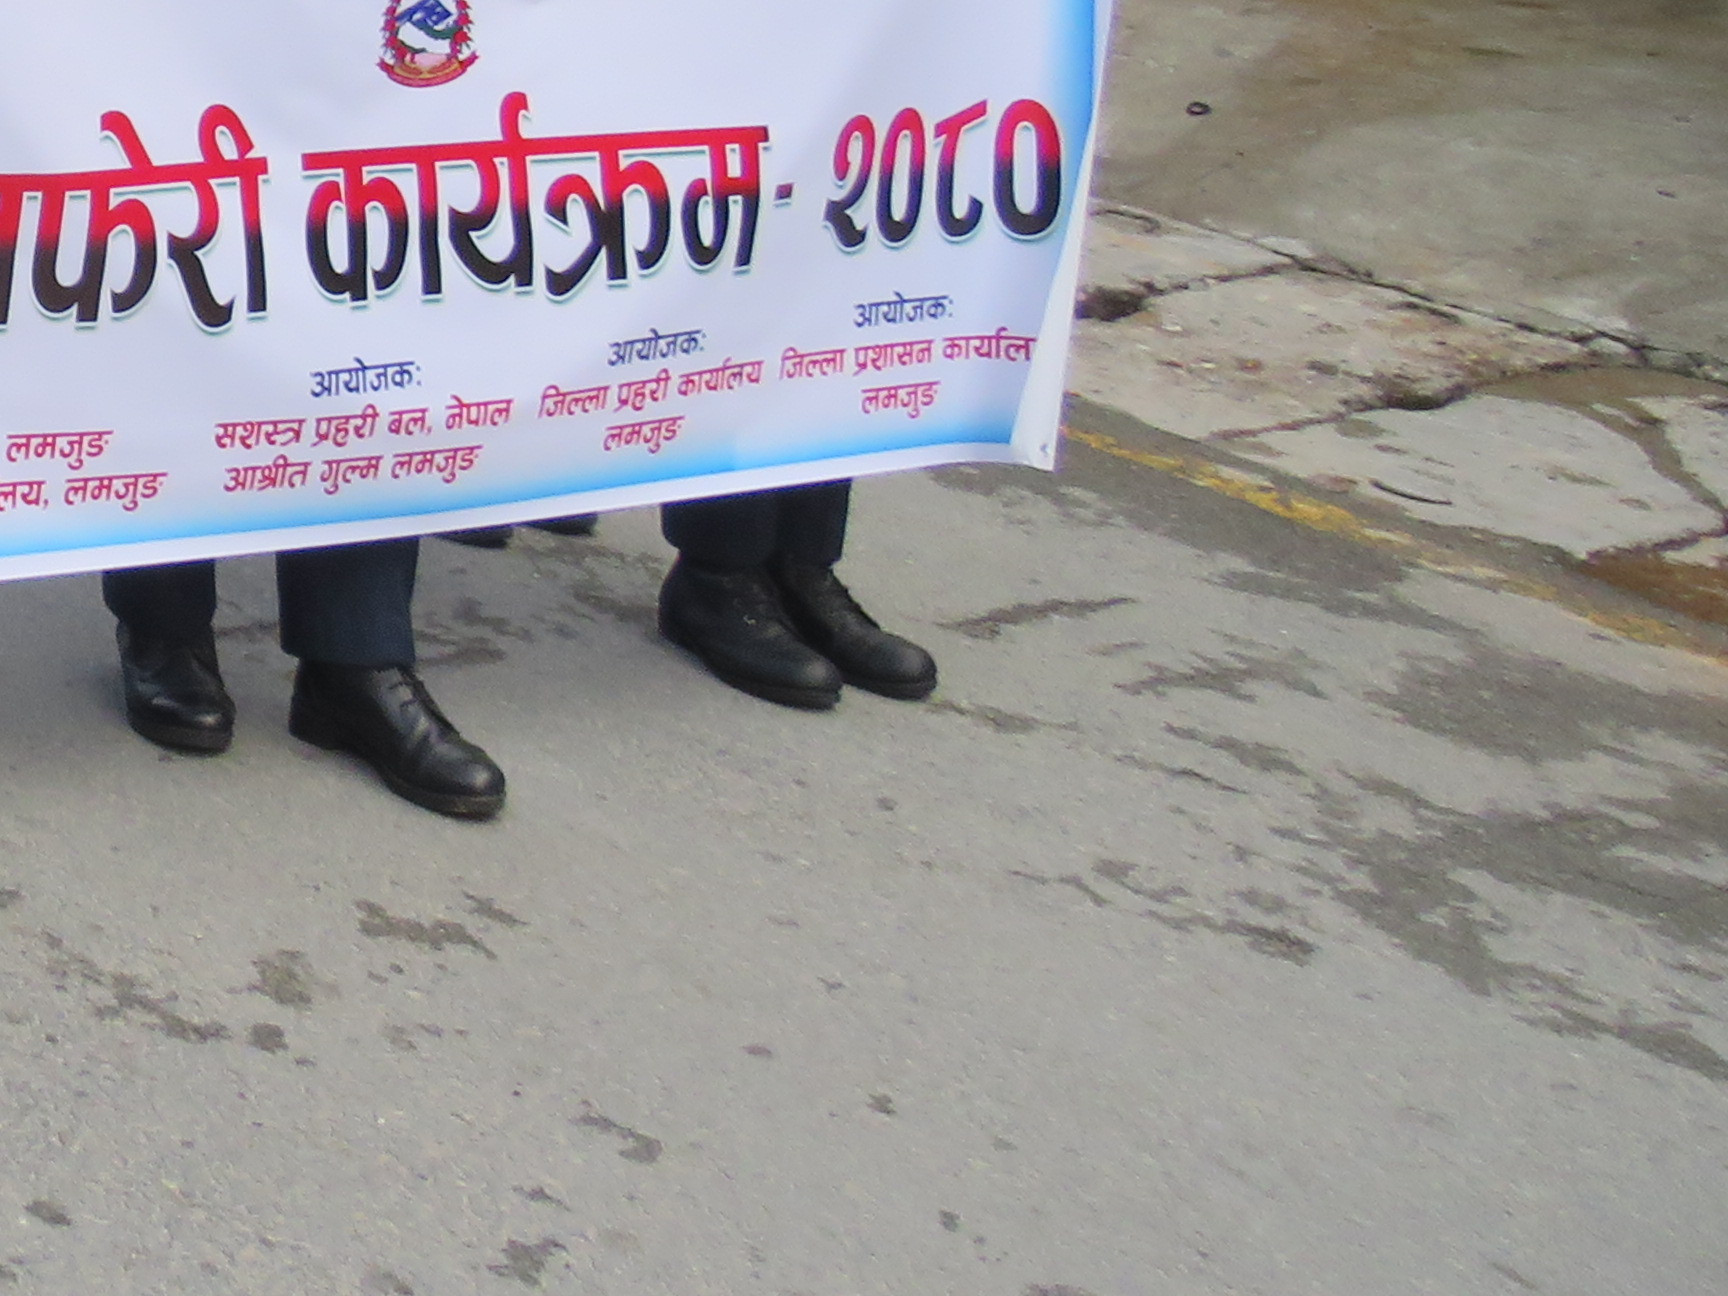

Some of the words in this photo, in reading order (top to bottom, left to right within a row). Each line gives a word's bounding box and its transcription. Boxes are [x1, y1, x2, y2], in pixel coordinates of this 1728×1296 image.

[823, 97, 1064, 258] २०८०
[853, 291, 954, 328] आयोजक:
[608, 327, 706, 368] आयोजक:
[779, 346, 847, 382] जिल्ला
[852, 337, 935, 377] प्रशासन
[942, 325, 1038, 363] कार्याल
[310, 357, 422, 399] आयोजक:
[537, 384, 610, 420] जिल्ला
[615, 370, 673, 414] प्रहरी
[677, 355, 765, 398] कार्यालय
[860, 378, 942, 420] लमजुङ
[214, 417, 306, 450] सशस्त्र
[310, 403, 380, 448] प्रहरी
[387, 406, 432, 437] बल,
[445, 394, 514, 432] नेपाल
[603, 414, 686, 454] लमजुङ
[6, 429, 115, 471] लमजुङ
[223, 453, 312, 493] आश्रीत
[319, 454, 384, 496] गुल्म
[391, 444, 484, 485] लमजुङ
[63, 471, 168, 512] लमजुङ
